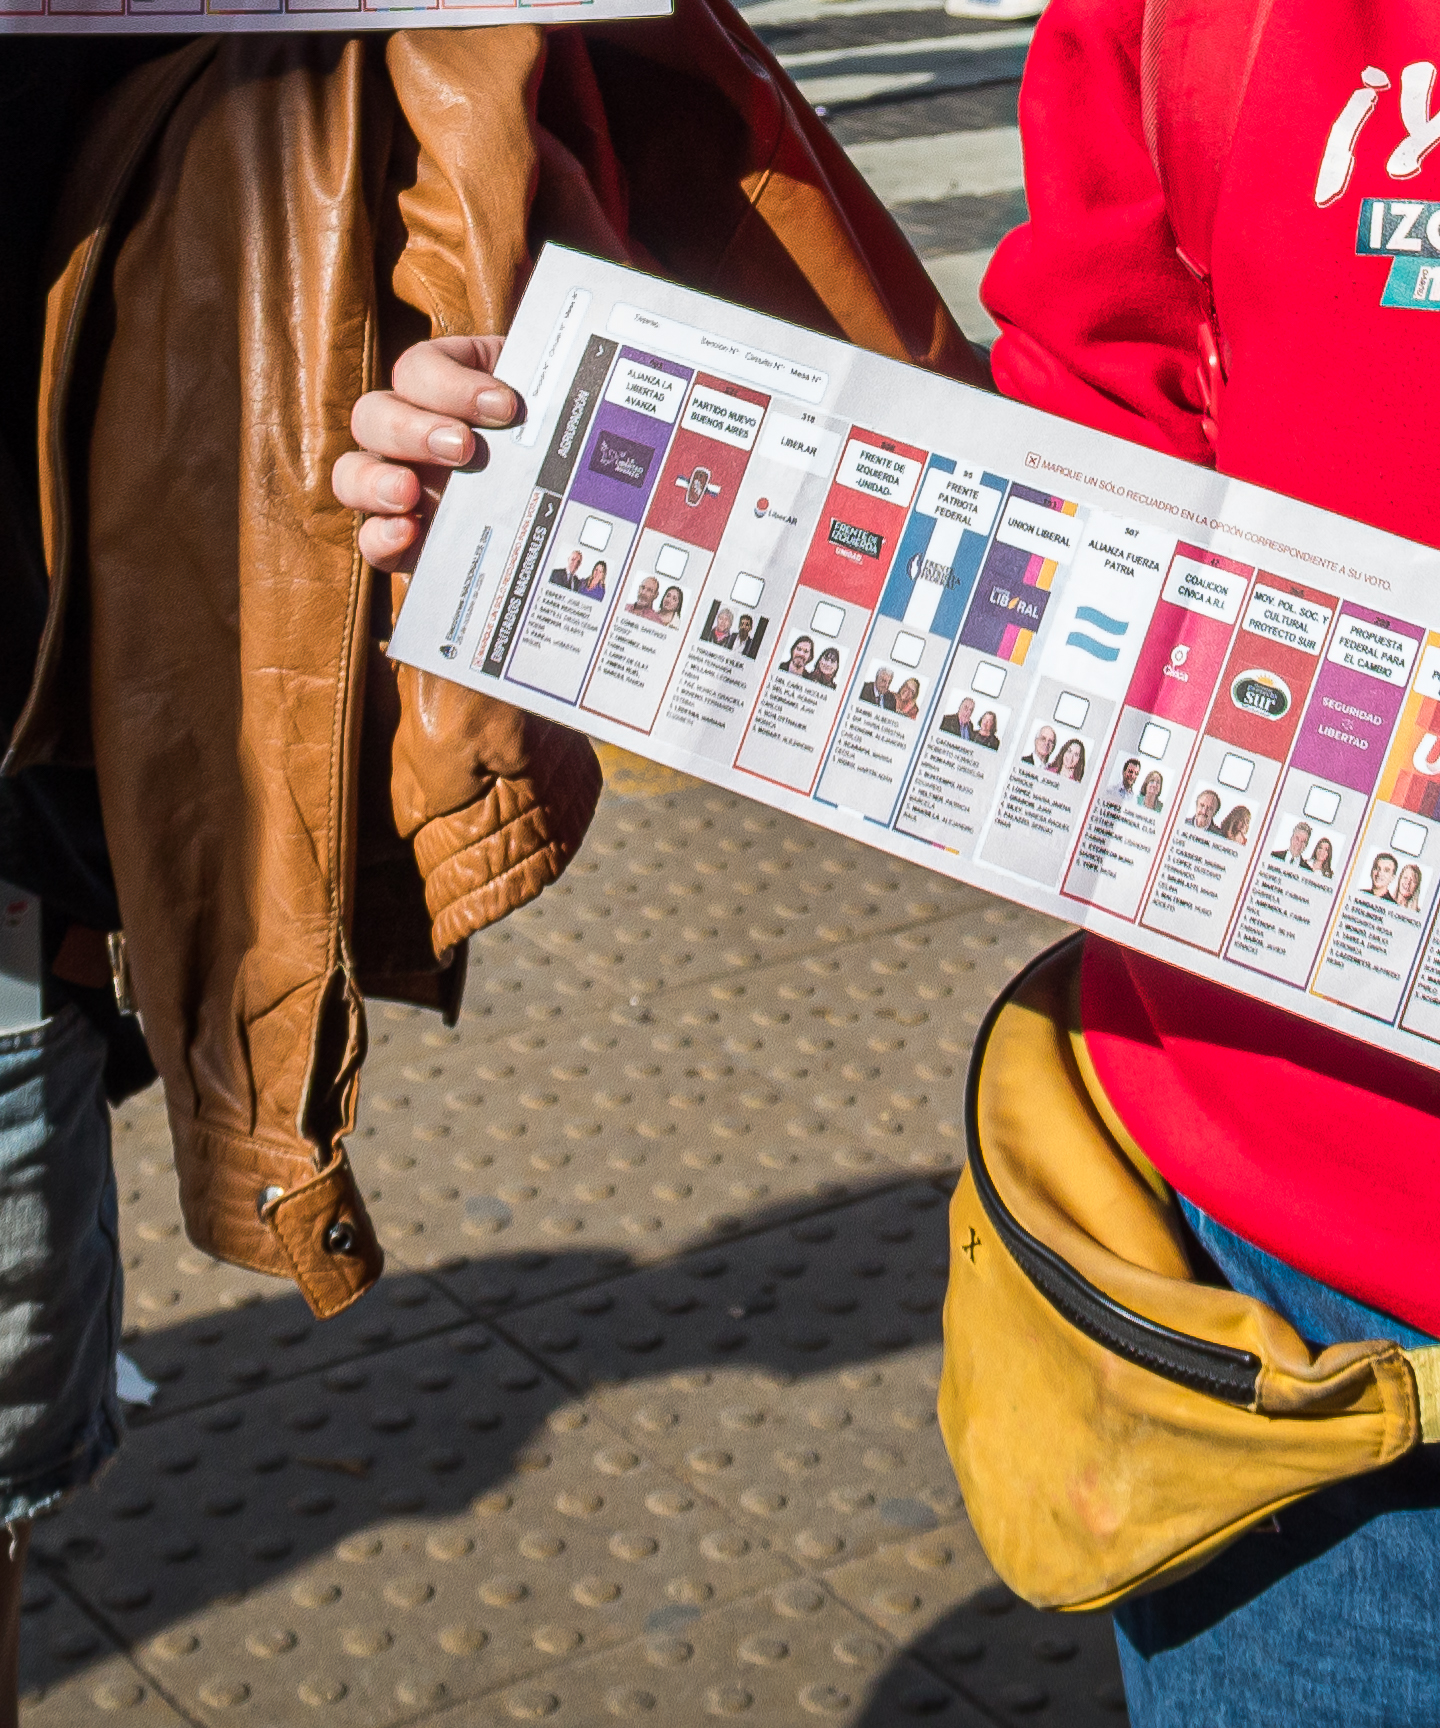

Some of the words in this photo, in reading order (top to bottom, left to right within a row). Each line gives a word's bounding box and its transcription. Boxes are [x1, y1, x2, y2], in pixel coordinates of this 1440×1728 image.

[625, 381, 665, 402] LIBERTAD
[626, 367, 659, 386] ALIANZA
[658, 379, 673, 391] LA
[624, 394, 657, 414] AVANZA
[691, 397, 727, 418] PARTIDO
[726, 409, 757, 428] NUEVO
[555, 389, 590, 459] AGRUPACIÓN
[689, 410, 724, 430] BUENOS
[723, 422, 749, 439] AIRES
[855, 462, 901, 486] IZQUIERDA
[859, 449, 892, 469] FRENTE
[891, 461, 906, 474] DE
[945, 480, 979, 500] FRENTE
[933, 504, 973, 527] FEDERAL
[937, 492, 979, 514] PATRIOTA
[829, 529, 878, 554] IZQUIERDA
[1006, 517, 1035, 534] UNION
[1035, 527, 1072, 548] LIBERAL
[1087, 538, 1125, 559] ALIANZA
[1125, 551, 1161, 572] FUERZA
[1103, 558, 1136, 577] PATRIA
[488, 596, 523, 663] DIPUTADOS
[511, 524, 548, 597] NACIONALES
[1184, 572, 1229, 596] COALICION
[1253, 590, 1277, 606] MOV.
[1277, 599, 1299, 614] POL.
[1298, 606, 1322, 622] SOC.
[1321, 614, 1329, 625] Y
[1262, 609, 1310, 633] CULTURAL
[1248, 618, 1297, 643] PROYECTO
[1296, 635, 1317, 650] SUR
[1349, 625, 1403, 652] PROPUESTA
[1338, 636, 1380, 659] FEDERAL
[1380, 651, 1406, 668] PARA
[1342, 652, 1356, 665] EL
[1355, 656, 1393, 678] CAMBIO
[1243, 689, 1276, 714] sur
[1321, 696, 1383, 726] SEGURIDAD
[1317, 724, 1369, 750] LIBERTAD
